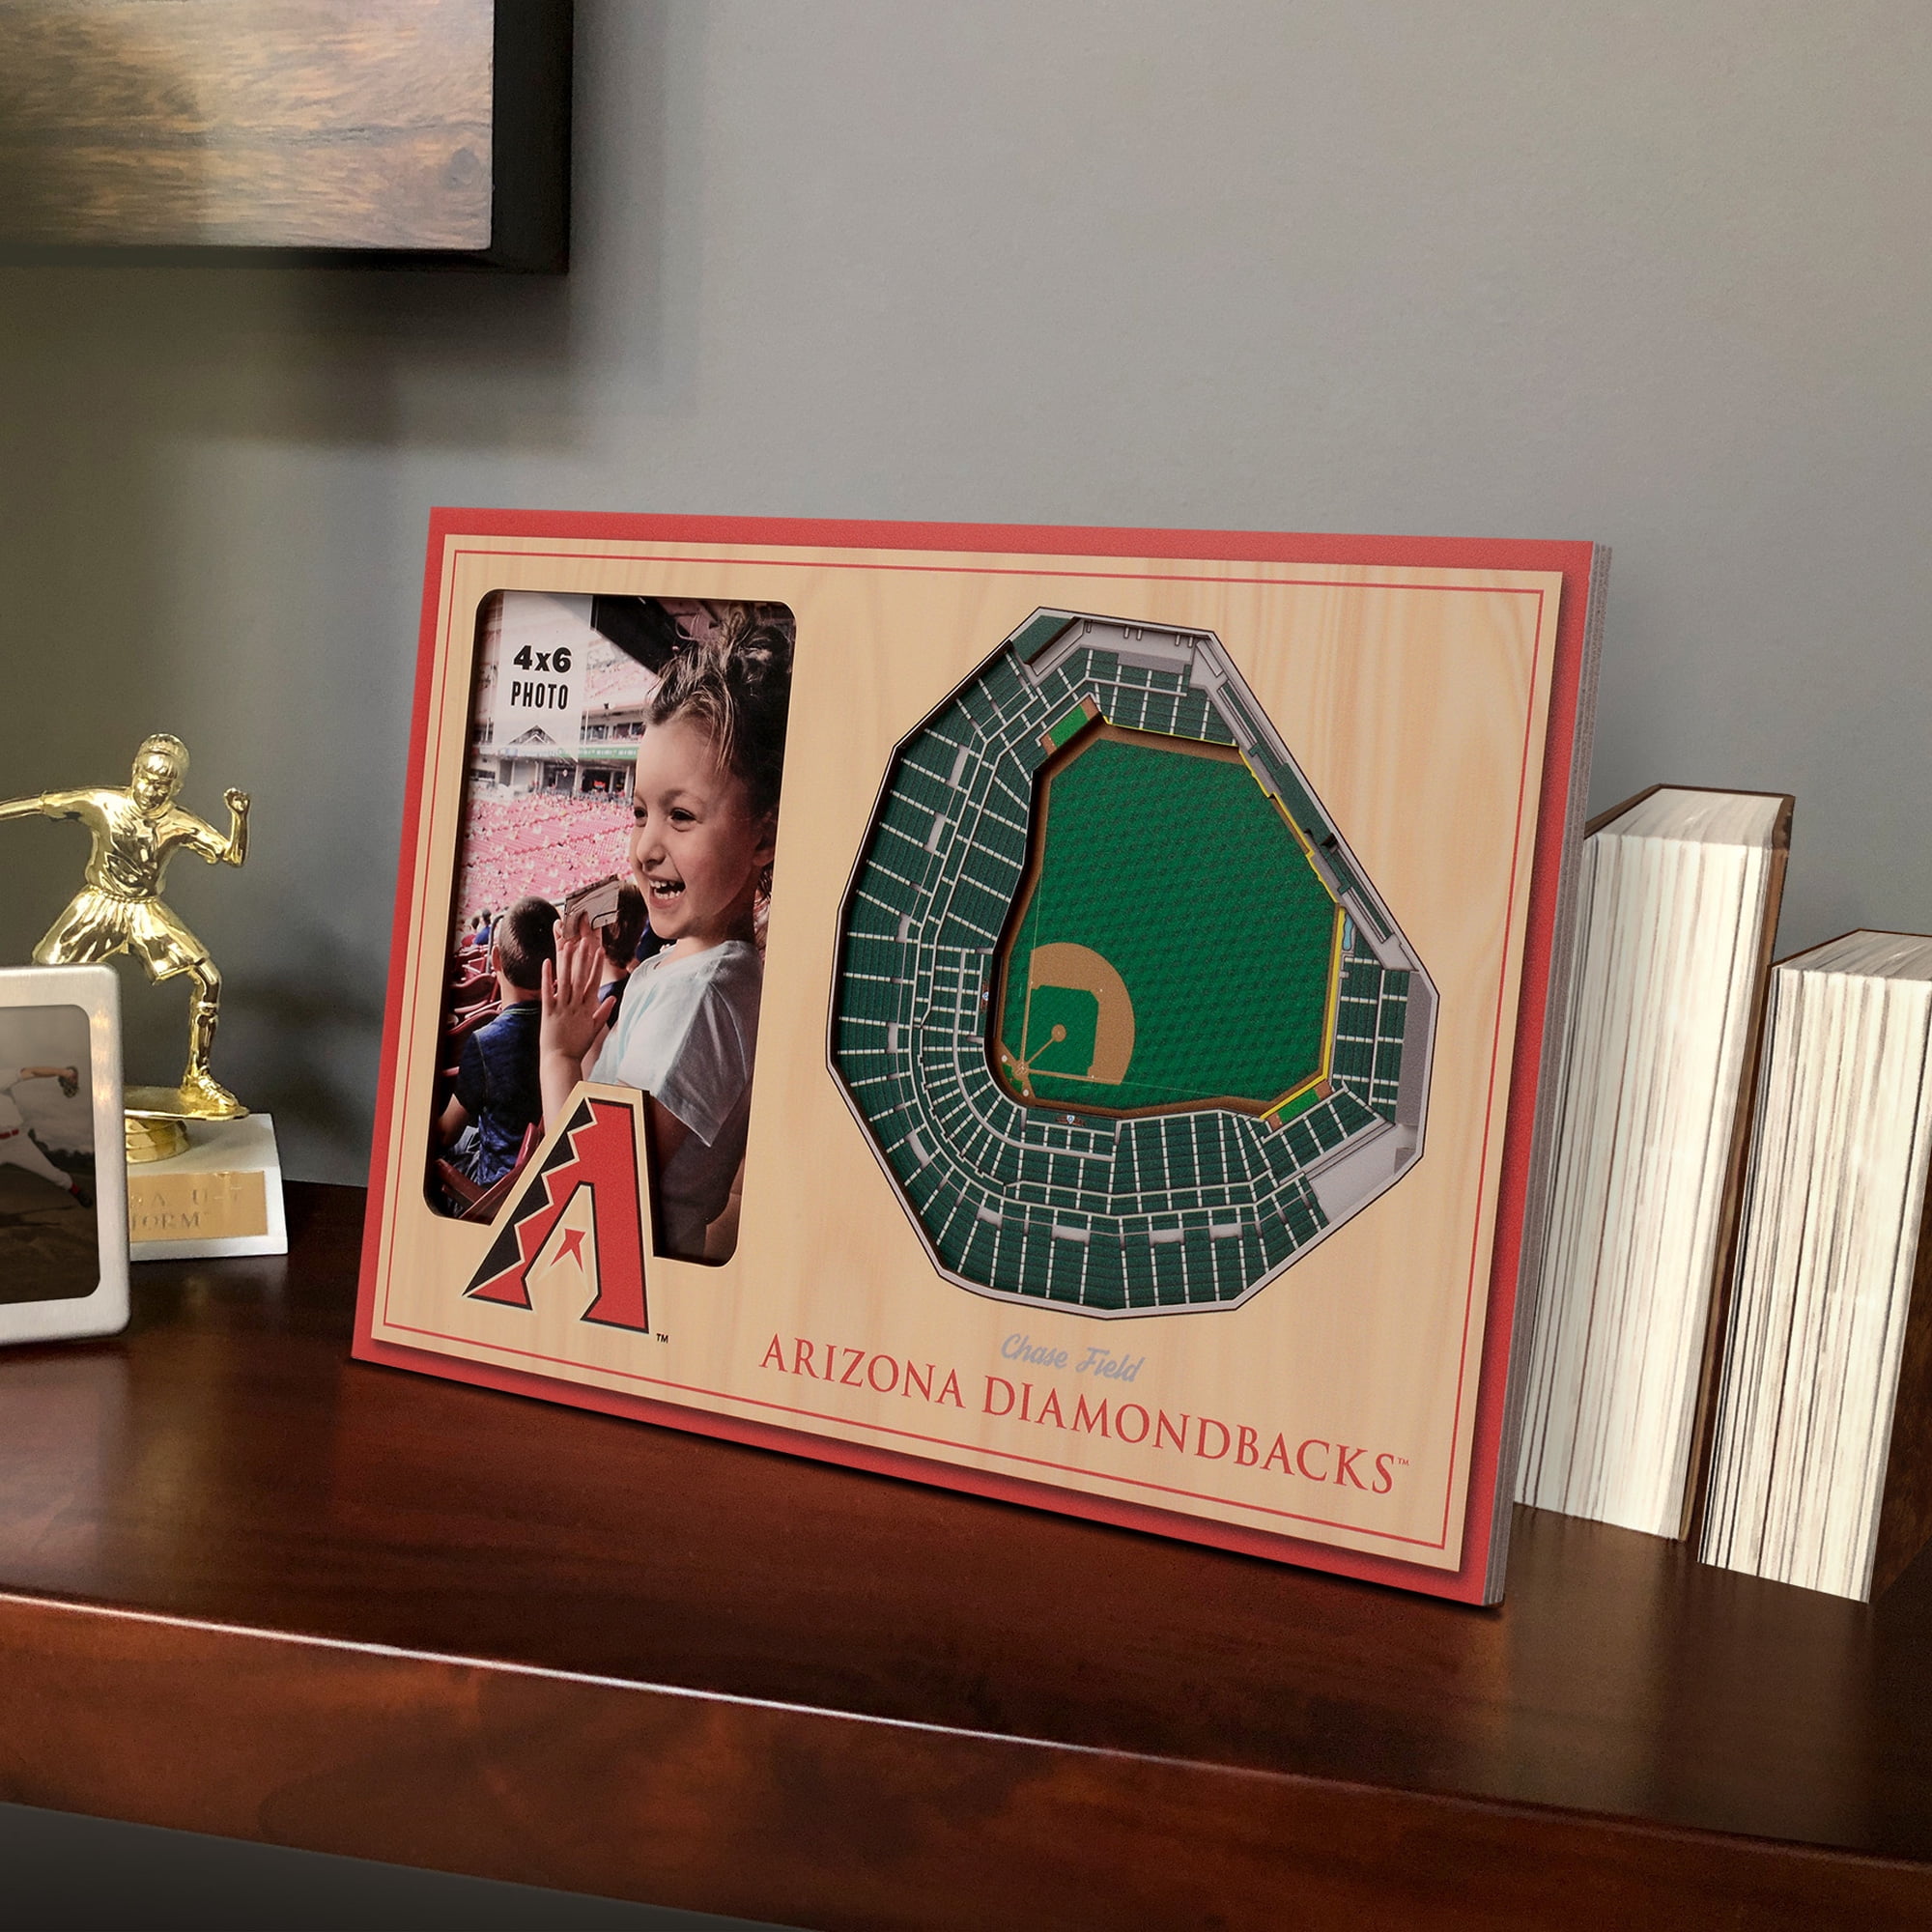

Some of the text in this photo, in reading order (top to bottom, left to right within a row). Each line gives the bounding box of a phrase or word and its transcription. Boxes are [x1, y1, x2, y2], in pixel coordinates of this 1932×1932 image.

[512, 644, 572, 673] 4x6
[510, 680, 568, 710] PHOTO
[1001, 1333, 1146, 1382] Chase Field
[758, 1333, 966, 1408] ARIZONA
[981, 1376, 1394, 1493] DIAMONDBACKS
